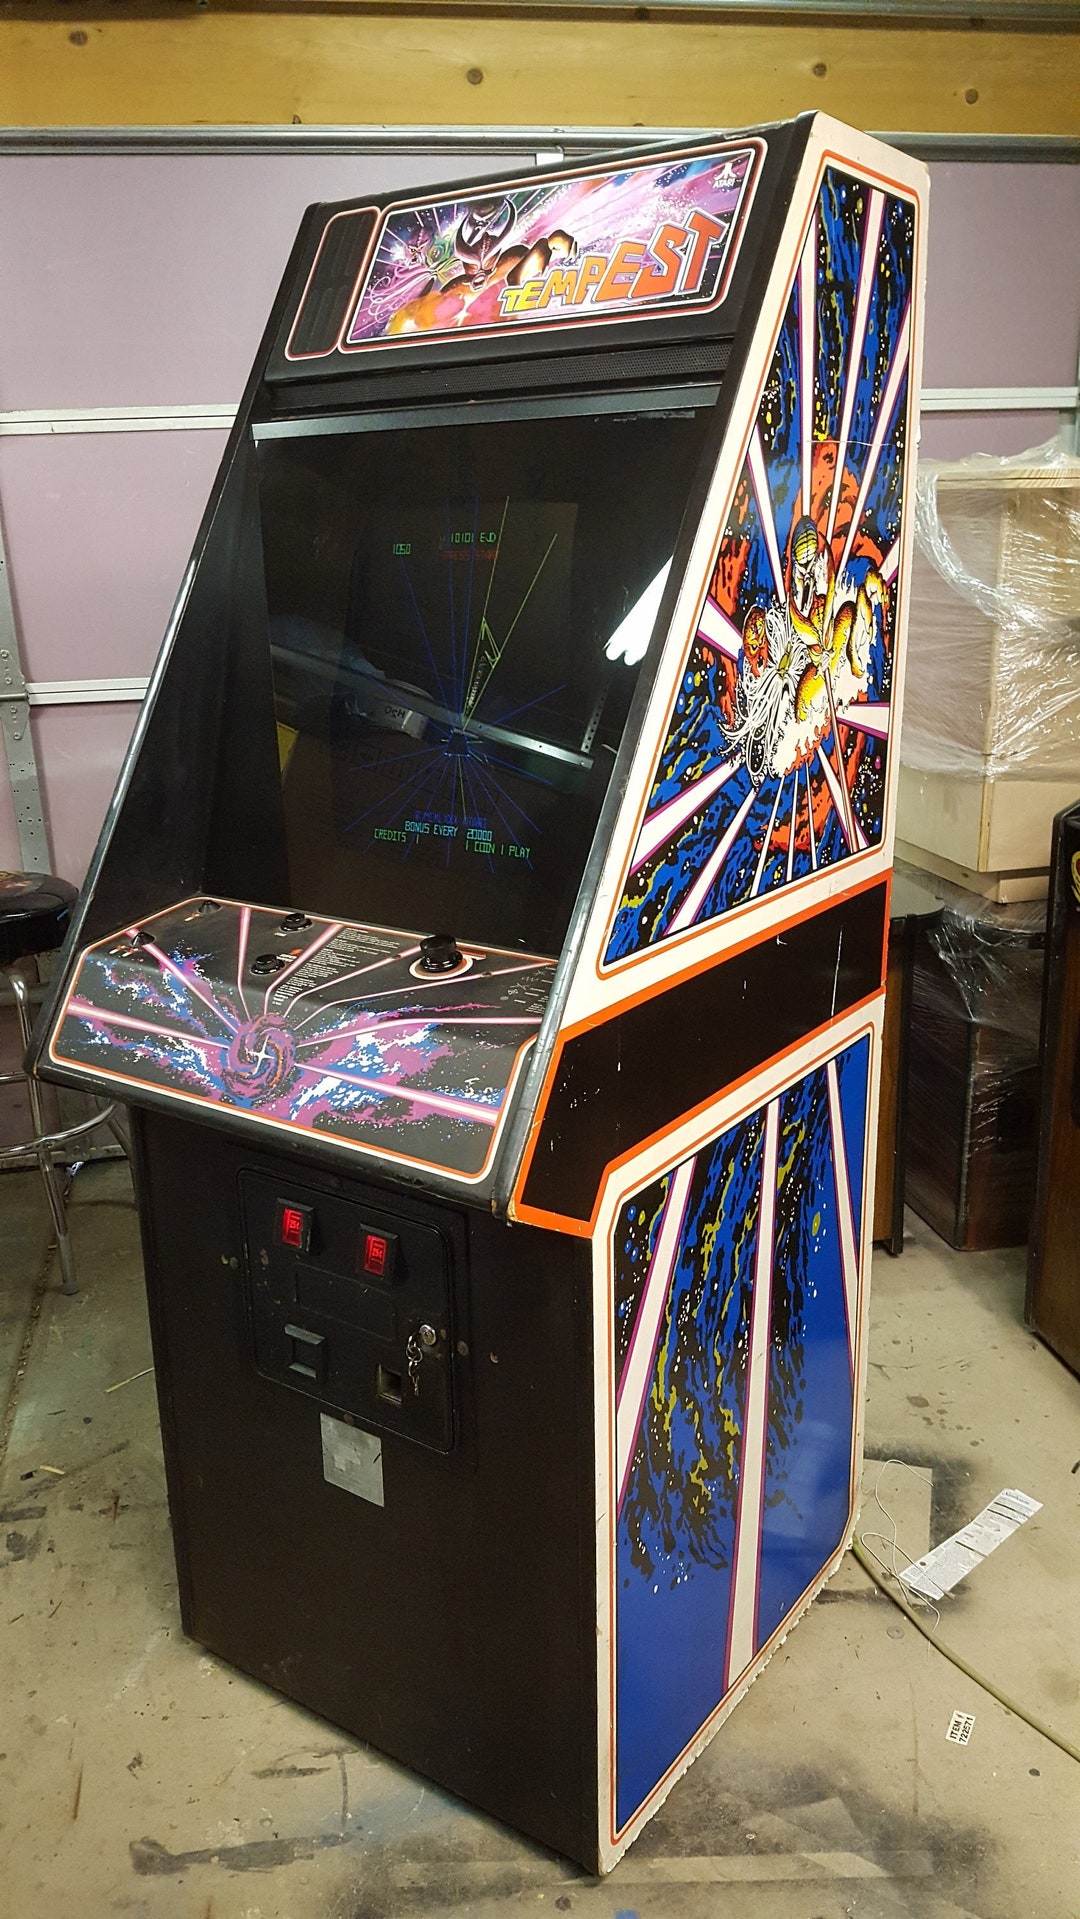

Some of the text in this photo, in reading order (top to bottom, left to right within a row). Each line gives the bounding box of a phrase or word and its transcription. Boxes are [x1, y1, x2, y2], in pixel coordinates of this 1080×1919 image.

[712, 178, 736, 188] ATARI
[498, 208, 730, 316] TEMPEST
[373, 828, 407, 843] CREDITS
[404, 820, 493, 842] BONUS EVERY 20000
[474, 841, 496, 854] COIN
[508, 845, 531, 859] PLAY
[950, 1720, 962, 1739] ITEM
[959, 1717, 973, 1742] 722571
